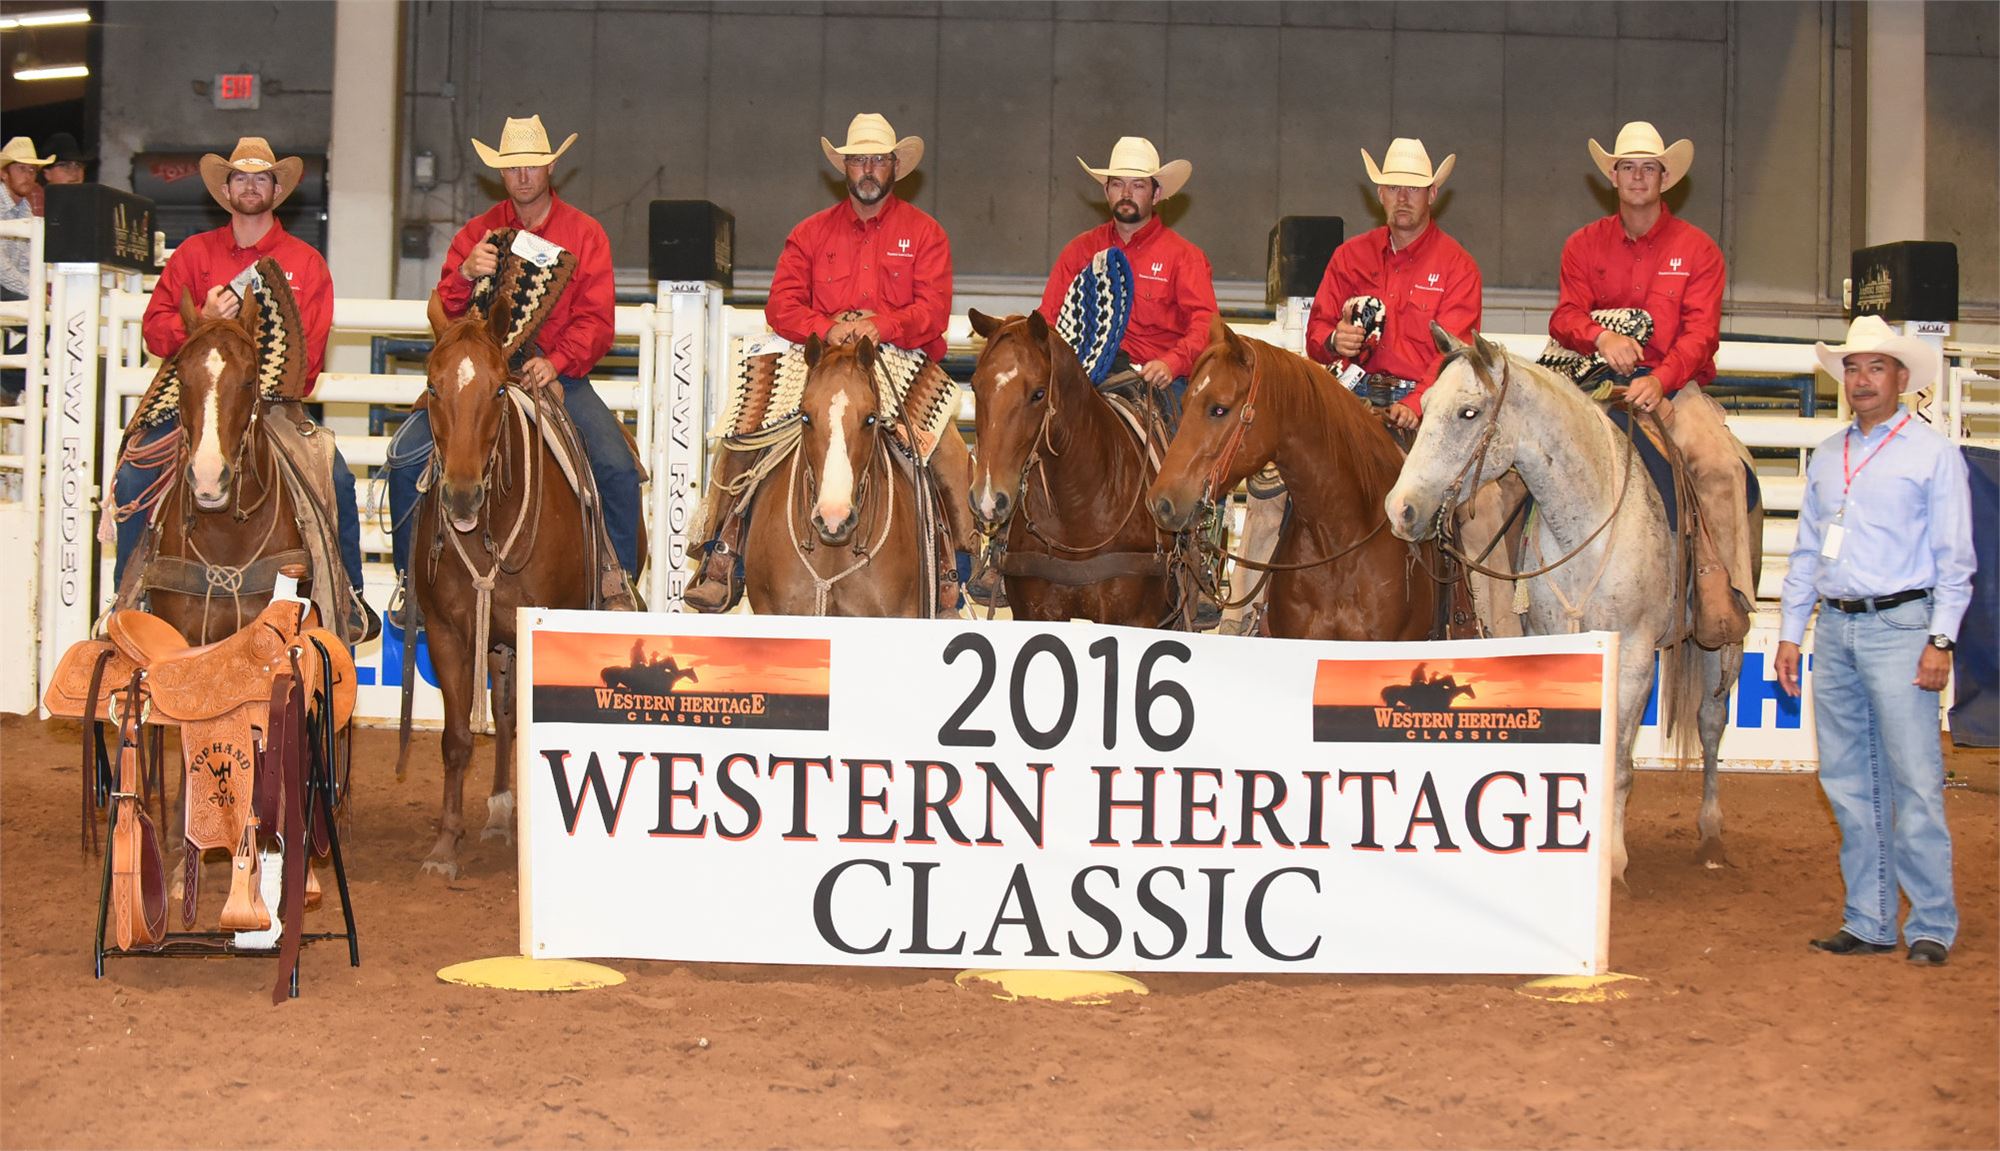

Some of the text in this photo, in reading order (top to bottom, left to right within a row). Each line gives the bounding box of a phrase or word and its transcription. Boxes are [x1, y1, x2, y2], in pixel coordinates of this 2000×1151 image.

[222, 74, 254, 99] EXIT
[60, 437, 80, 607] RODEO
[593, 688, 766, 715] WESTERN HERITAGE
[937, 632, 1194, 752] 2016
[627, 711, 732, 725] CLASSIC
[1373, 707, 1542, 729] WESTERN HERITAGE
[1406, 729, 1509, 741] CLASSIC
[190, 742, 251, 773] TOP HAND
[208, 791, 235, 808] 2016
[539, 749, 1591, 855] WESTERN HERITAGE
[812, 858, 1322, 962] CLASSIC
